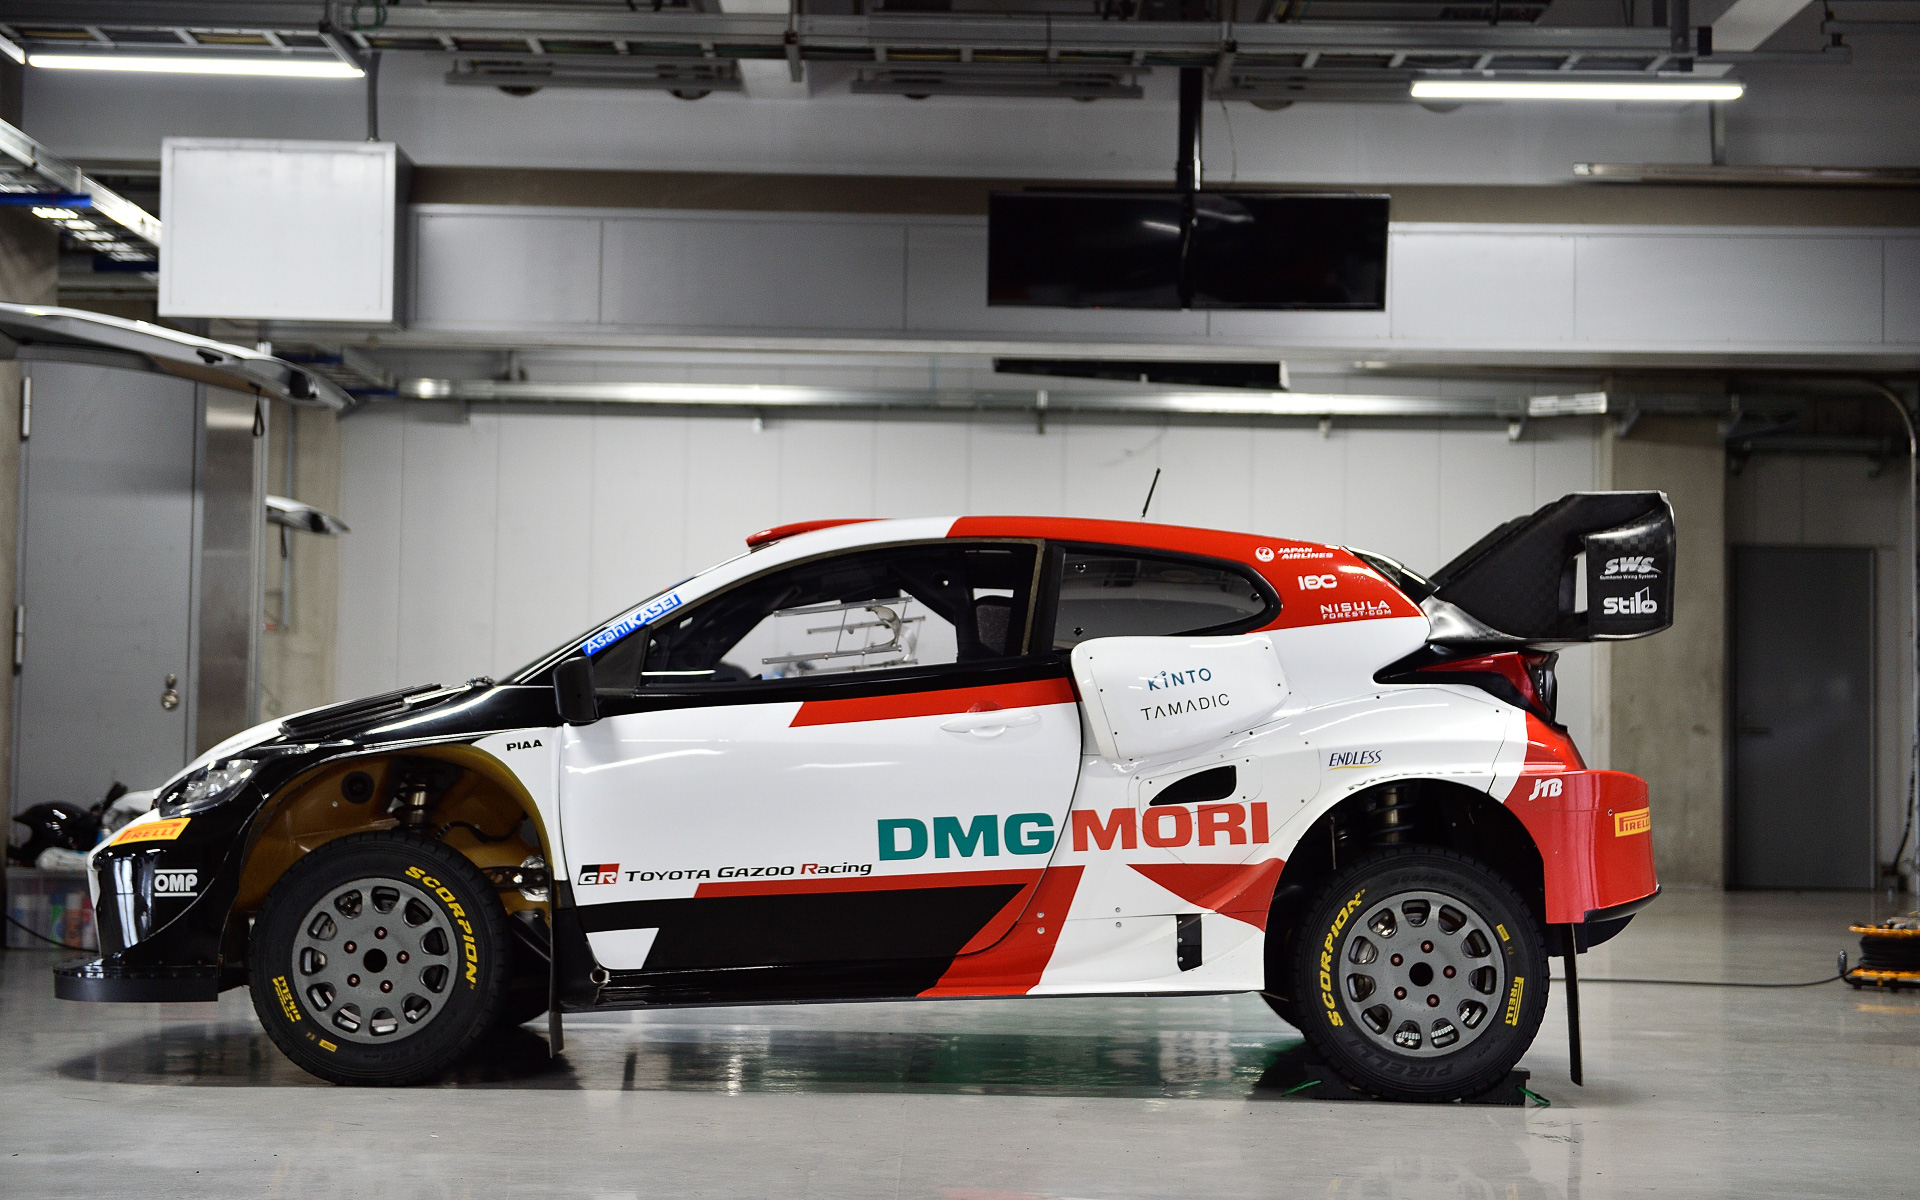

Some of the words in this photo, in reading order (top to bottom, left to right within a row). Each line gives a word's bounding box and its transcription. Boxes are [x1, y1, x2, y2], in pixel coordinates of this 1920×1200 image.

[1604, 556, 1656, 575] SWS
[1320, 600, 1390, 614] NISULA
[1603, 586, 1658, 614] Stilo
[1141, 693, 1230, 720] TAMADIC
[506, 739, 543, 751] PIAA
[1328, 749, 1383, 767] ENDLESS
[1528, 778, 1562, 801] JTB
[117, 822, 182, 842] PIRELLI
[877, 812, 1055, 861] DMG
[1071, 801, 1270, 852] MORI
[154, 873, 198, 892] OMP
[624, 869, 710, 882] TOYOTA
[717, 866, 795, 879] GAZOO
[800, 861, 873, 876] Racing
[405, 866, 478, 984] SCORPION
[1319, 891, 1363, 1027] SCORPION
[1504, 976, 1525, 1026] PIRELLI
